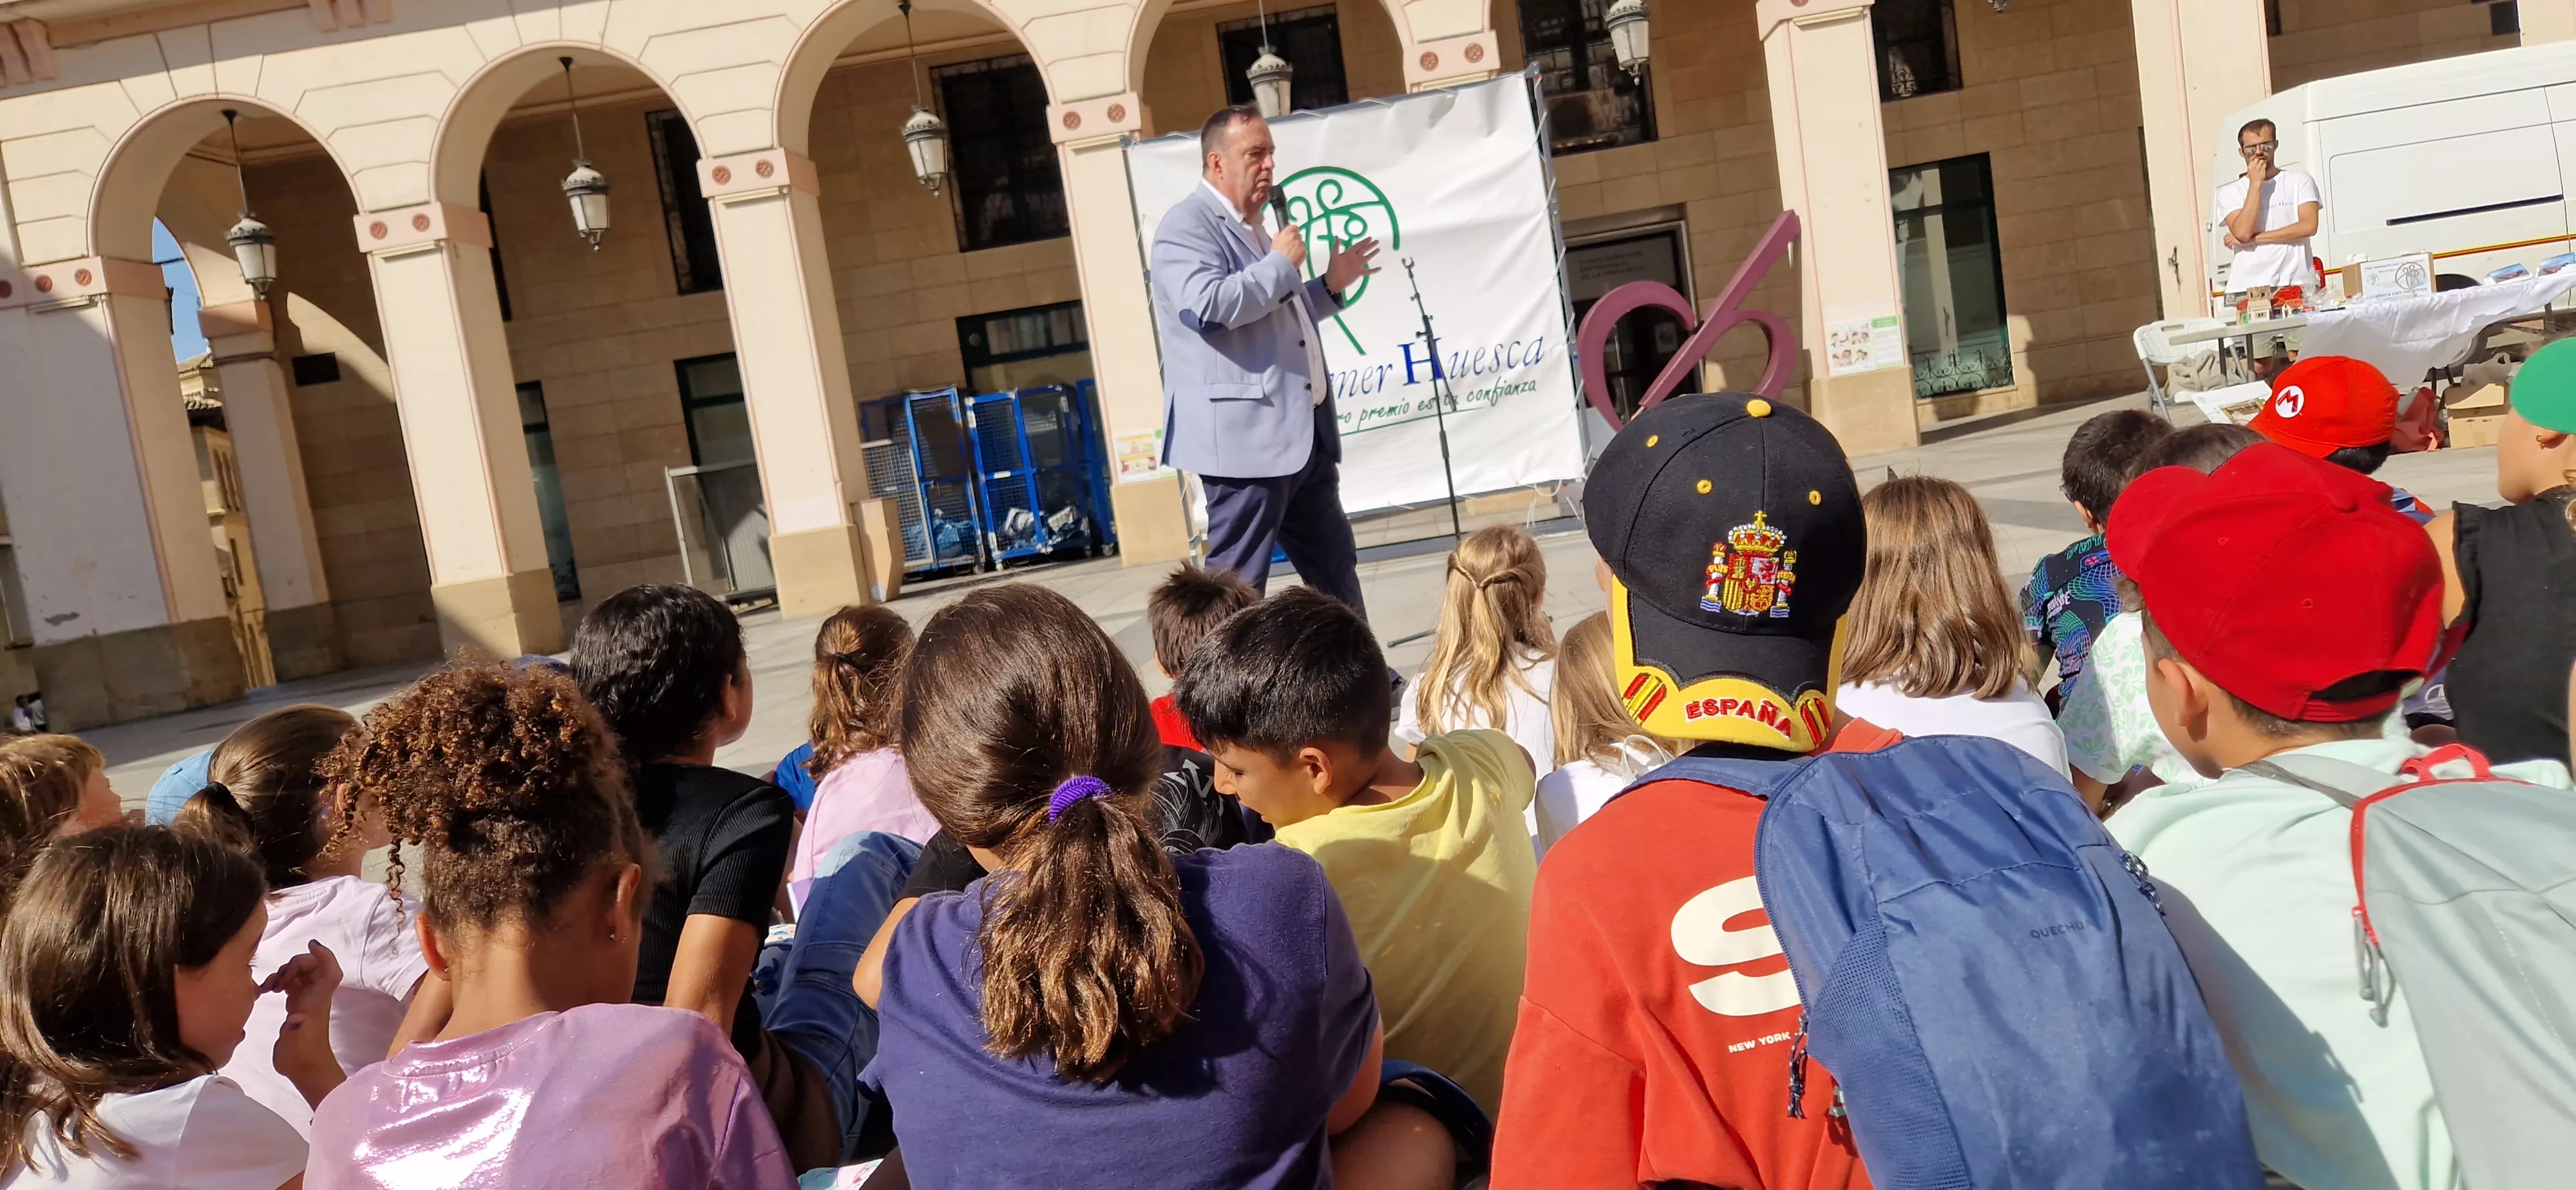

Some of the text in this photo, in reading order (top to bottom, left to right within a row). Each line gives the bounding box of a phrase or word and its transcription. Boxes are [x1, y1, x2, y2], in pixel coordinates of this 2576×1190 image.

[1397, 336, 1544, 386] Huesca
[1357, 397, 1410, 431] premio
[1466, 376, 1537, 407] confianza
[2277, 390, 2299, 413] M
[1685, 698, 1792, 738] ESPAÑA
[1728, 1031, 1792, 1053] NEW YORK
